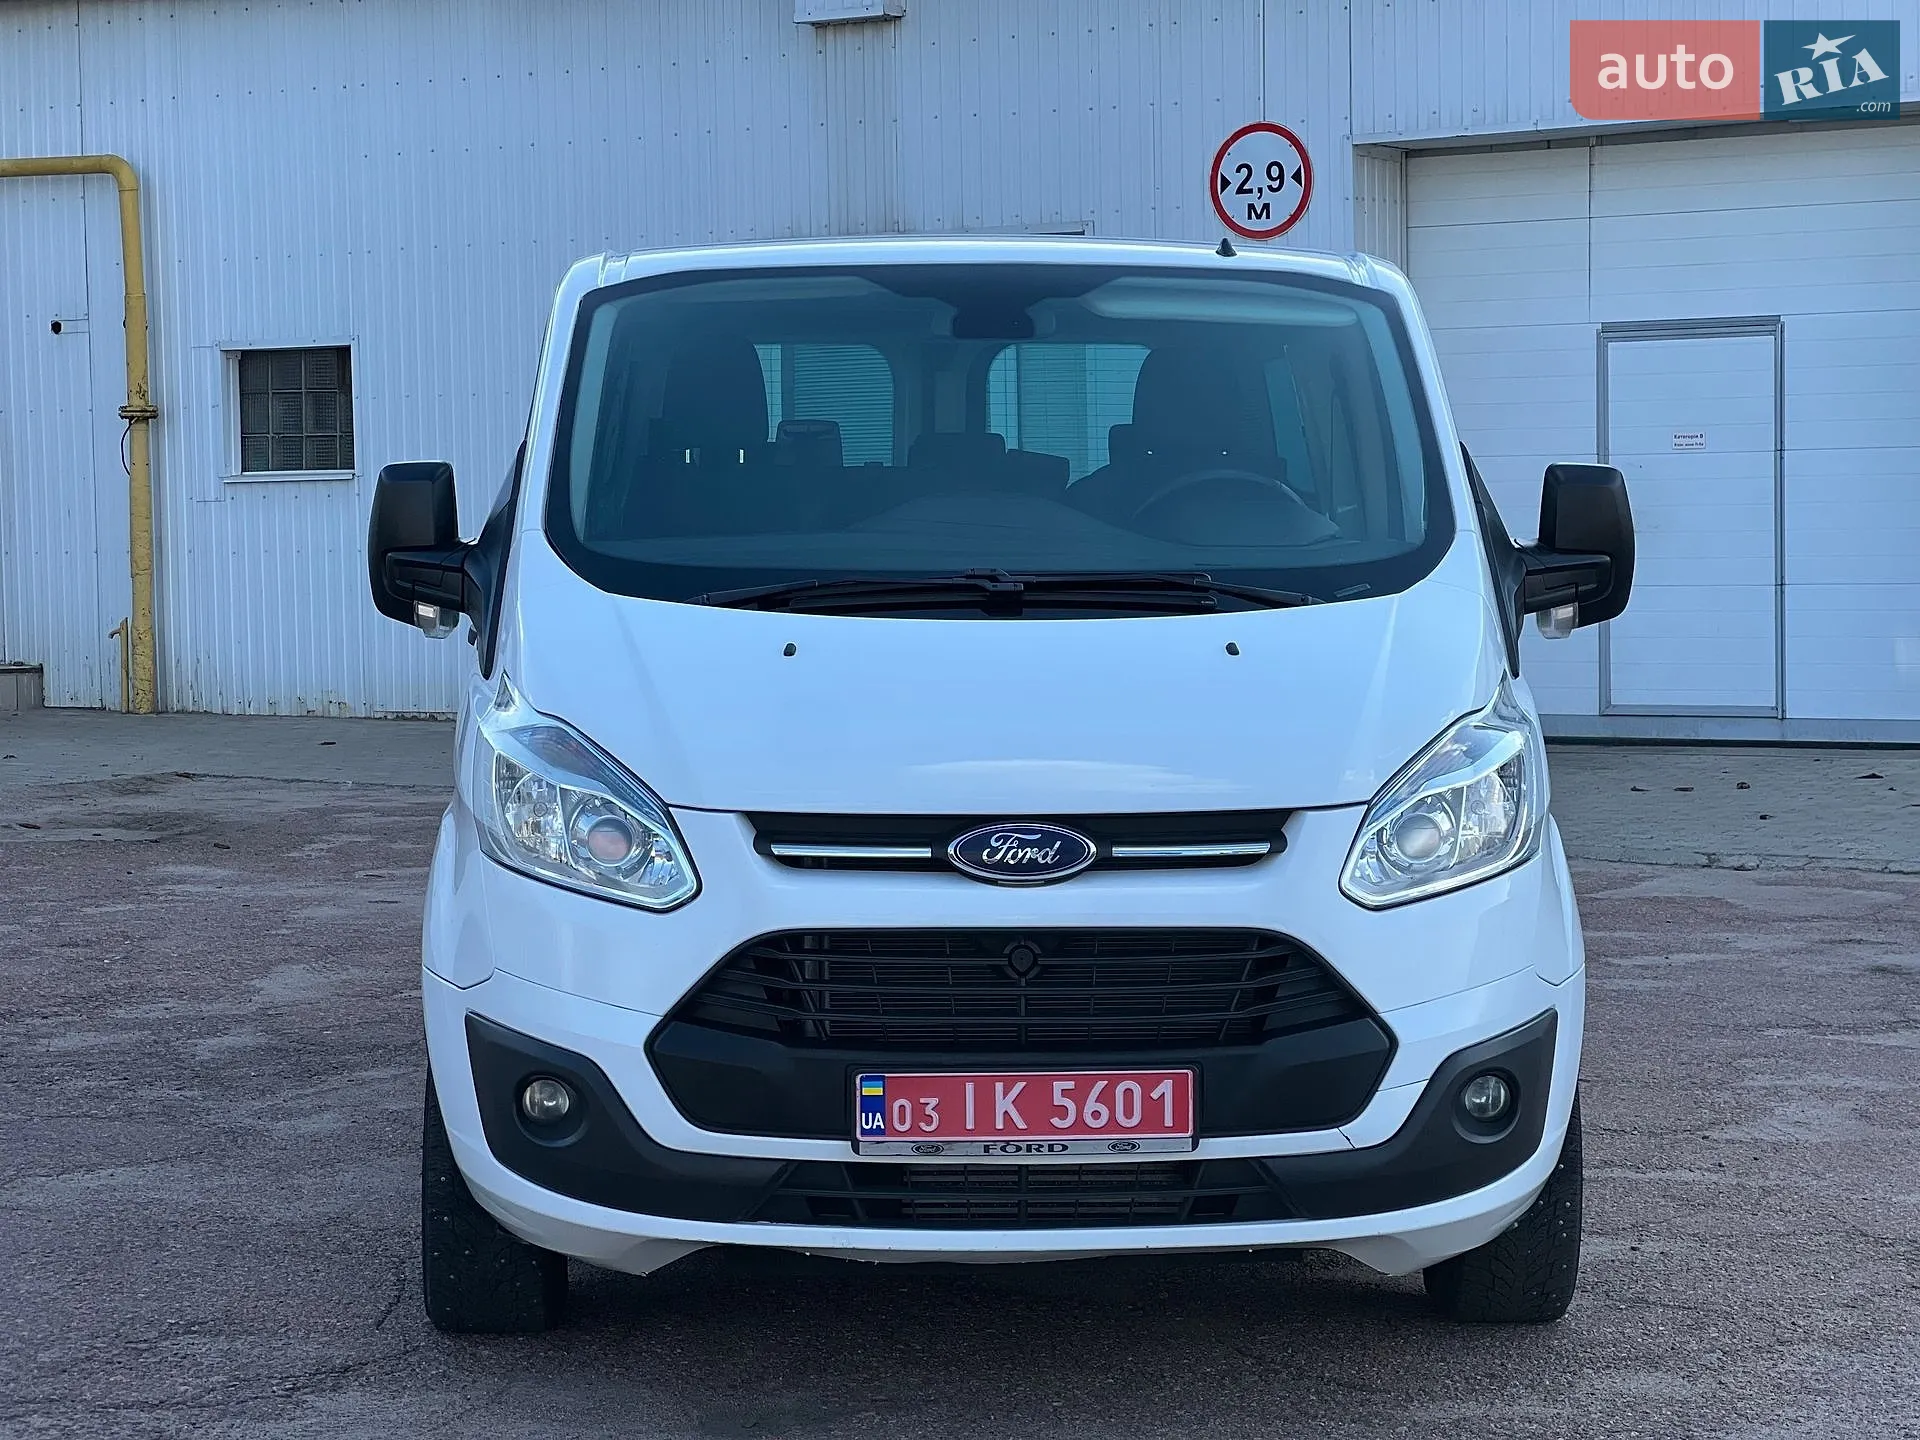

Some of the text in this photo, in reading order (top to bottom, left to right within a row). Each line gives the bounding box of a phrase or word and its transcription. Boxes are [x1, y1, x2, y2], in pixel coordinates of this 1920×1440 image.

[1235, 160, 1285, 201] 2,9
[981, 832, 1062, 865] Ford
[861, 1112, 885, 1130] UA
[891, 1079, 1174, 1133] 03 IK 5601
[983, 1141, 1069, 1154] FORD
